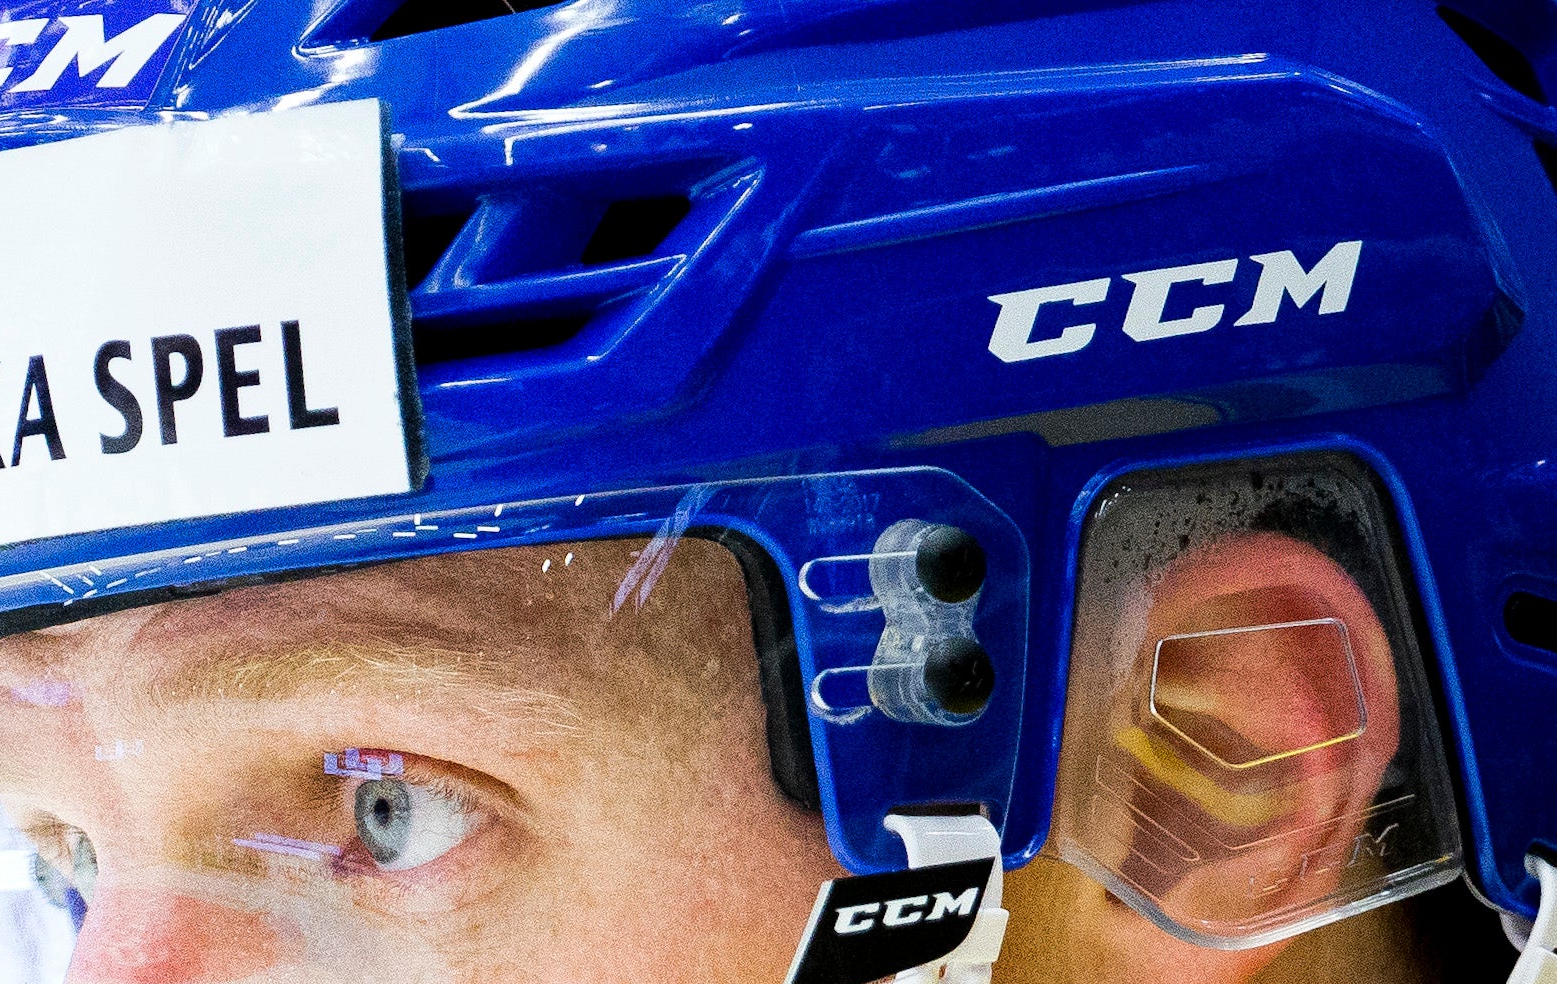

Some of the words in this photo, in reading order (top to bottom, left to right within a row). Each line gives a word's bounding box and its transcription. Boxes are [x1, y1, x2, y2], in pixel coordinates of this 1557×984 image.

[986, 240, 1363, 363] CCM
[92, 318, 340, 455] SPEL
[833, 886, 979, 934] CCM
